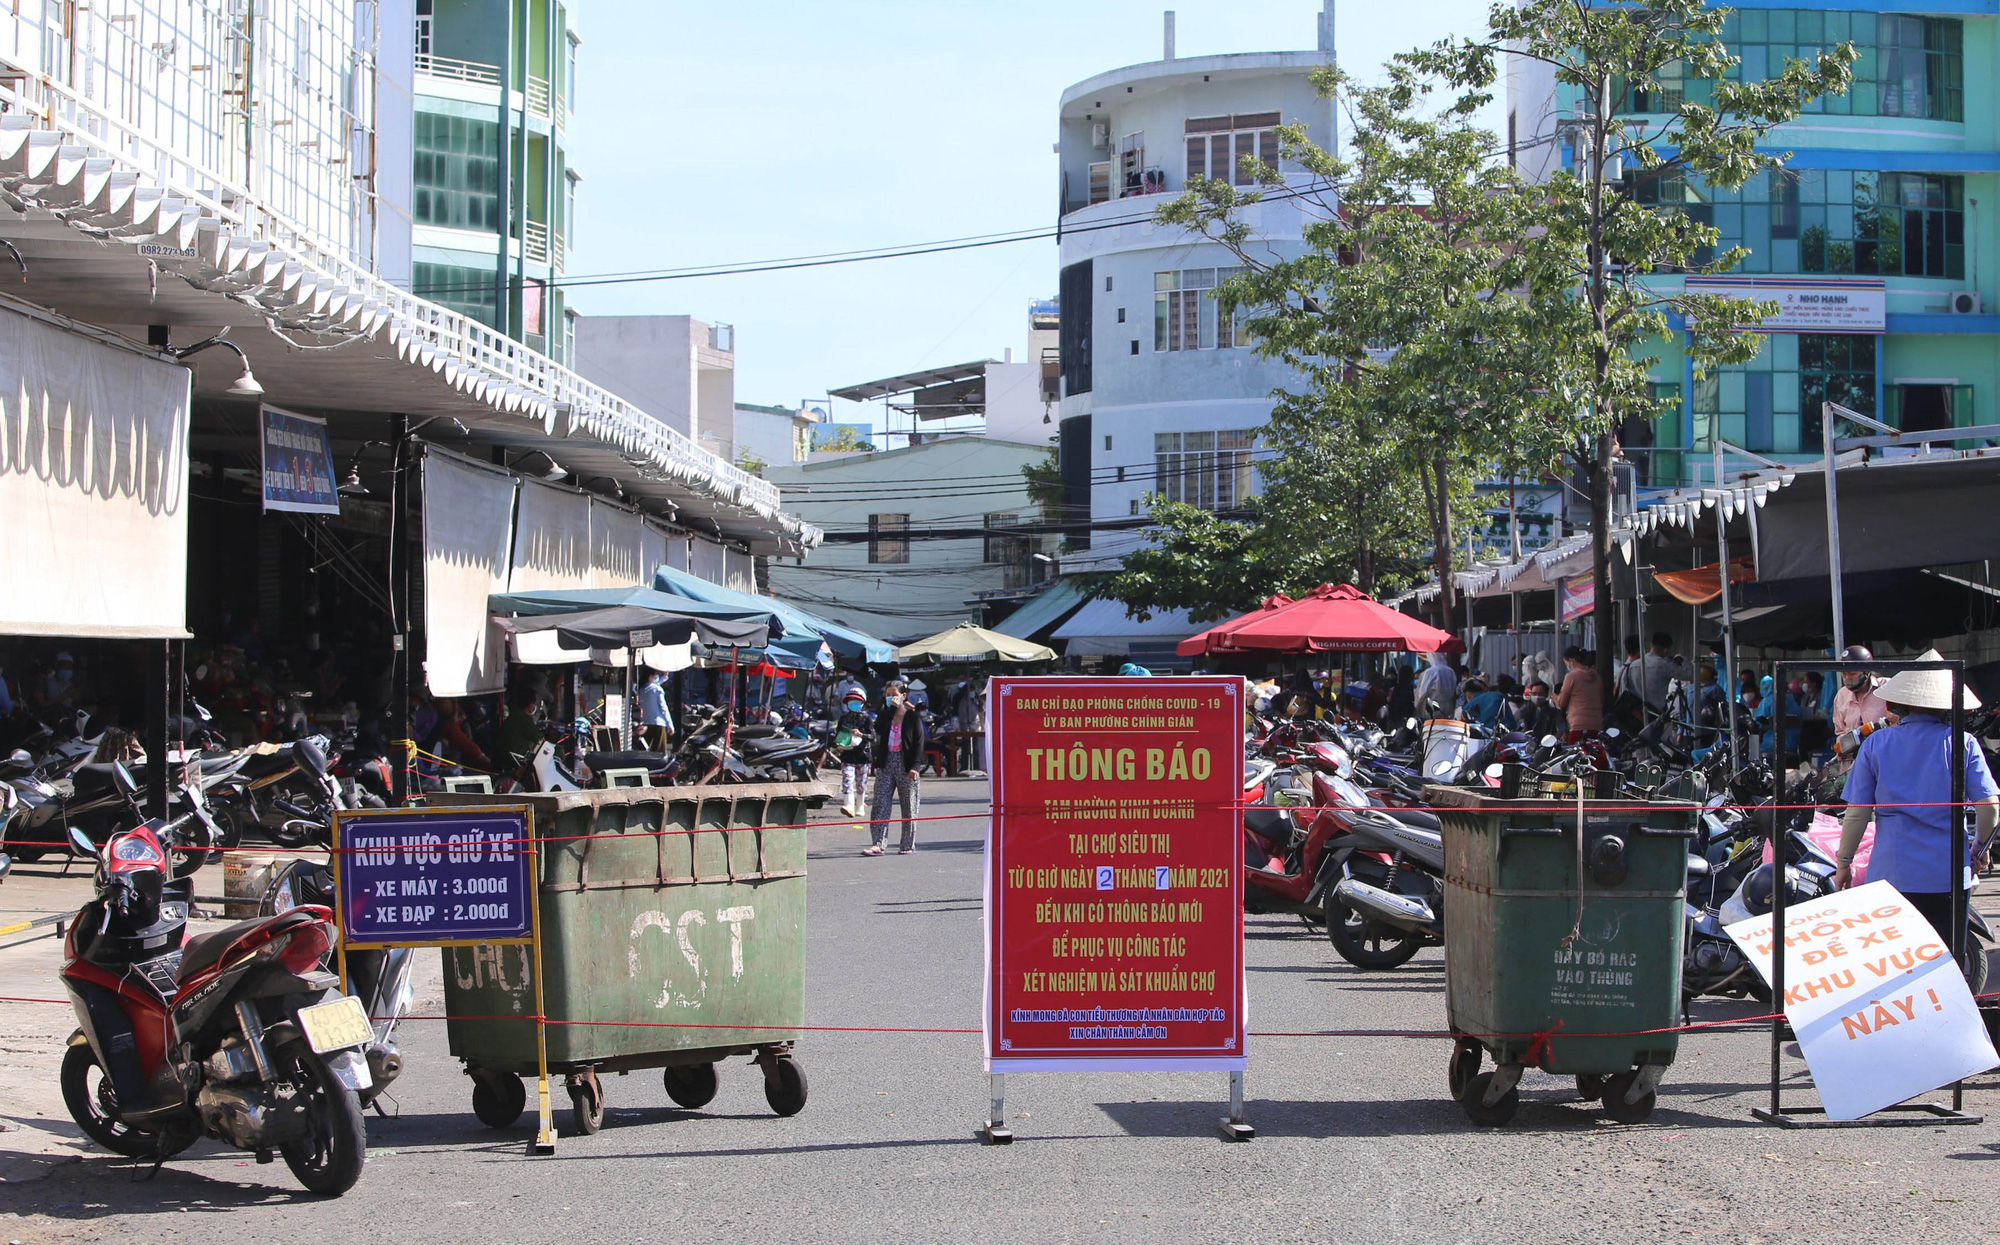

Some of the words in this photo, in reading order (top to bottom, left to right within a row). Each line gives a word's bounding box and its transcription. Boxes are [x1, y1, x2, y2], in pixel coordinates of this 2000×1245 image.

[1822, 296, 1847, 305] HẠNH
[1017, 698, 1039, 709] BAN
[1042, 696, 1060, 709] CHỈ
[1062, 698, 1084, 712] ĐẠO
[1086, 696, 1124, 709] PHÒNG
[1126, 694, 1164, 709] CHỐNG
[1166, 698, 1198, 709] COVID
[1208, 698, 1220, 709] 19
[1044, 713, 1058, 727] ỦY
[1060, 717, 1082, 727] BAN
[1084, 715, 1129, 728] PHƯỜNG
[1132, 714, 1165, 727] CHÍNH
[1168, 714, 1194, 727] GIÁN
[1027, 742, 1135, 780] THÔNG
[1146, 741, 1211, 780] BÁO
[1045, 800, 1070, 823] TẠM
[1074, 796, 1116, 819] NGỪNG
[1120, 800, 1149, 819] KINH
[1153, 800, 1194, 819] DOANH
[355, 836, 395, 866] KHU
[402, 833, 442, 871] VỰC
[448, 828, 484, 864] GIỮ
[489, 833, 515, 862] XE
[1069, 833, 1088, 858] TẠI
[1091, 833, 1117, 858] CHỢ
[1120, 830, 1148, 854] SIÊU
[1150, 833, 1170, 858] THỊ
[376, 881, 396, 896] XE
[402, 877, 438, 896] MÁY
[453, 877, 508, 894] 3.000đ
[1008, 864, 1024, 888] TỪ
[1037, 864, 1058, 888] GIỜ
[1061, 864, 1094, 888] NGÀY
[1099, 869, 1112, 887] 2
[1115, 864, 1154, 888] THÁNG
[1157, 868, 1168, 887] 7
[1169, 865, 1197, 888] NĂM
[1201, 869, 1228, 888] 2021
[1798, 870, 1818, 883] YAMAHA
[376, 907, 397, 923] XE
[402, 905, 435, 925] ĐẠP
[454, 903, 508, 921] 2.000đ
[1036, 897, 1061, 922] ĐẾN
[1064, 903, 1084, 922] KHI
[1088, 899, 1103, 922] CÓ
[1108, 899, 1147, 922] THÔNG
[1151, 899, 1175, 922] BÁO
[1179, 898, 1202, 922] MỚI
[1784, 909, 1838, 927] ÒNG
[1756, 905, 1902, 956] KHÔNG
[1053, 930, 1069, 957] ĐỂ
[1072, 937, 1104, 961] PHỤC
[1108, 937, 1123, 961] VỤ
[1126, 933, 1159, 957] CÔNG
[1163, 933, 1186, 957] TÁC
[1802, 936, 1848, 966] ĐỂ
[1856, 926, 1903, 949] XE
[1023, 968, 1045, 992] XÉT
[1049, 967, 1097, 995] NGHIỆM
[1101, 968, 1116, 992] VÀ
[1120, 968, 1143, 992] SÁT
[1146, 964, 1188, 992] KHUẨN
[1191, 970, 1216, 995] CHỢ
[1784, 969, 1855, 1006] KHU
[1863, 943, 1944, 978] VỰC
[1011, 1007, 1031, 1022] KÍNH
[1032, 1010, 1056, 1022] MONG
[1057, 1008, 1069, 1021] BÀ
[1070, 1010, 1086, 1021] CON
[1087, 1006, 1105, 1022] TIỂU
[1107, 1008, 1138, 1022] THƯƠNG
[1139, 1007, 1149, 1021] VÀ
[1150, 1007, 1173, 1021] NHÂN
[1174, 1007, 1190, 1021] DÂN
[1192, 1008, 1207, 1024] HỢP
[1209, 1007, 1225, 1021] TÁC
[1841, 995, 1915, 1040] NÀY
[1069, 1027, 1084, 1039] XIN
[1085, 1026, 1107, 1039] CHÂN
[1108, 1026, 1135, 1039] THÀNH
[1136, 1025, 1155, 1039] CẢM
[1156, 1027, 1167, 1039] ƠN
